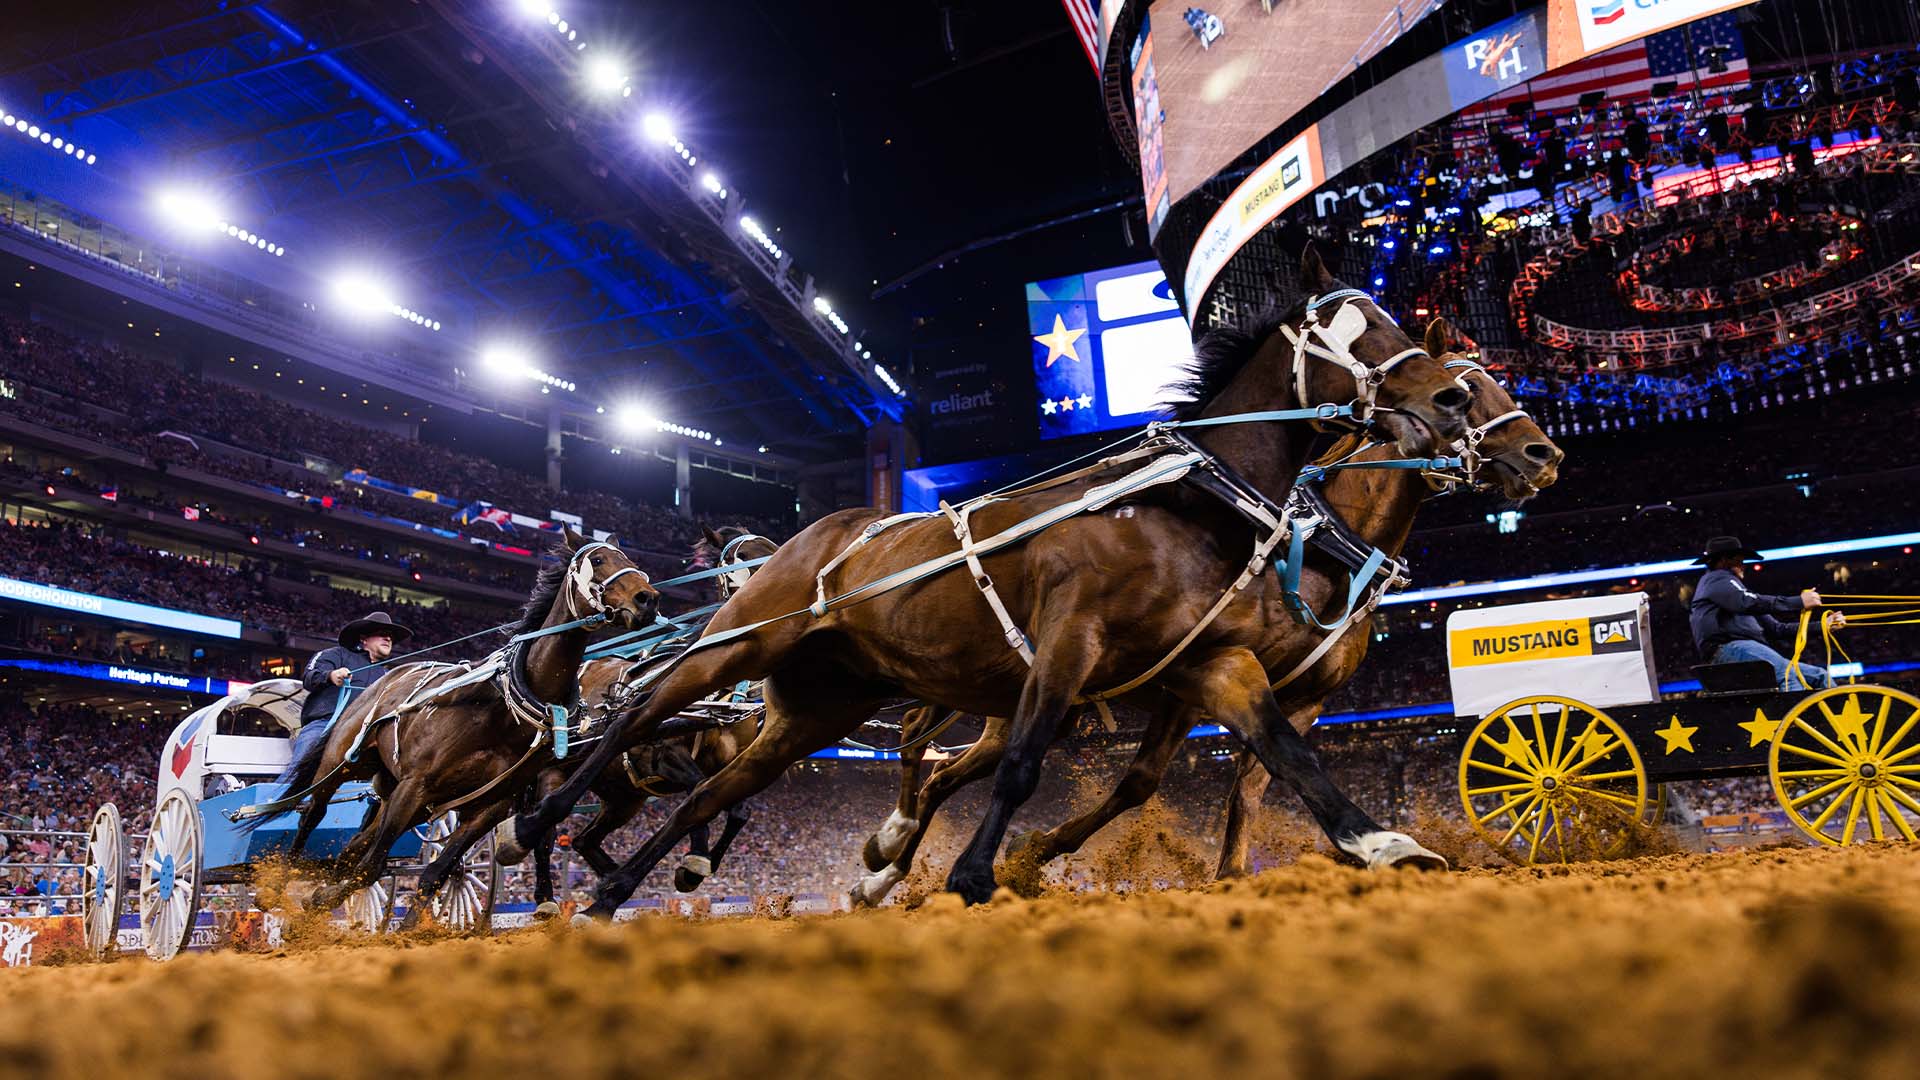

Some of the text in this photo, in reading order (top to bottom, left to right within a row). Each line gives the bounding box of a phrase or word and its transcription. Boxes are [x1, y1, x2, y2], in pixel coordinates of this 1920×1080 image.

[1245, 179, 1281, 214] MUSTANG
[930, 389, 993, 415] reliant
[1472, 619, 1635, 657] MUSTANG CAT
[109, 666, 190, 688] Heritage Partner
